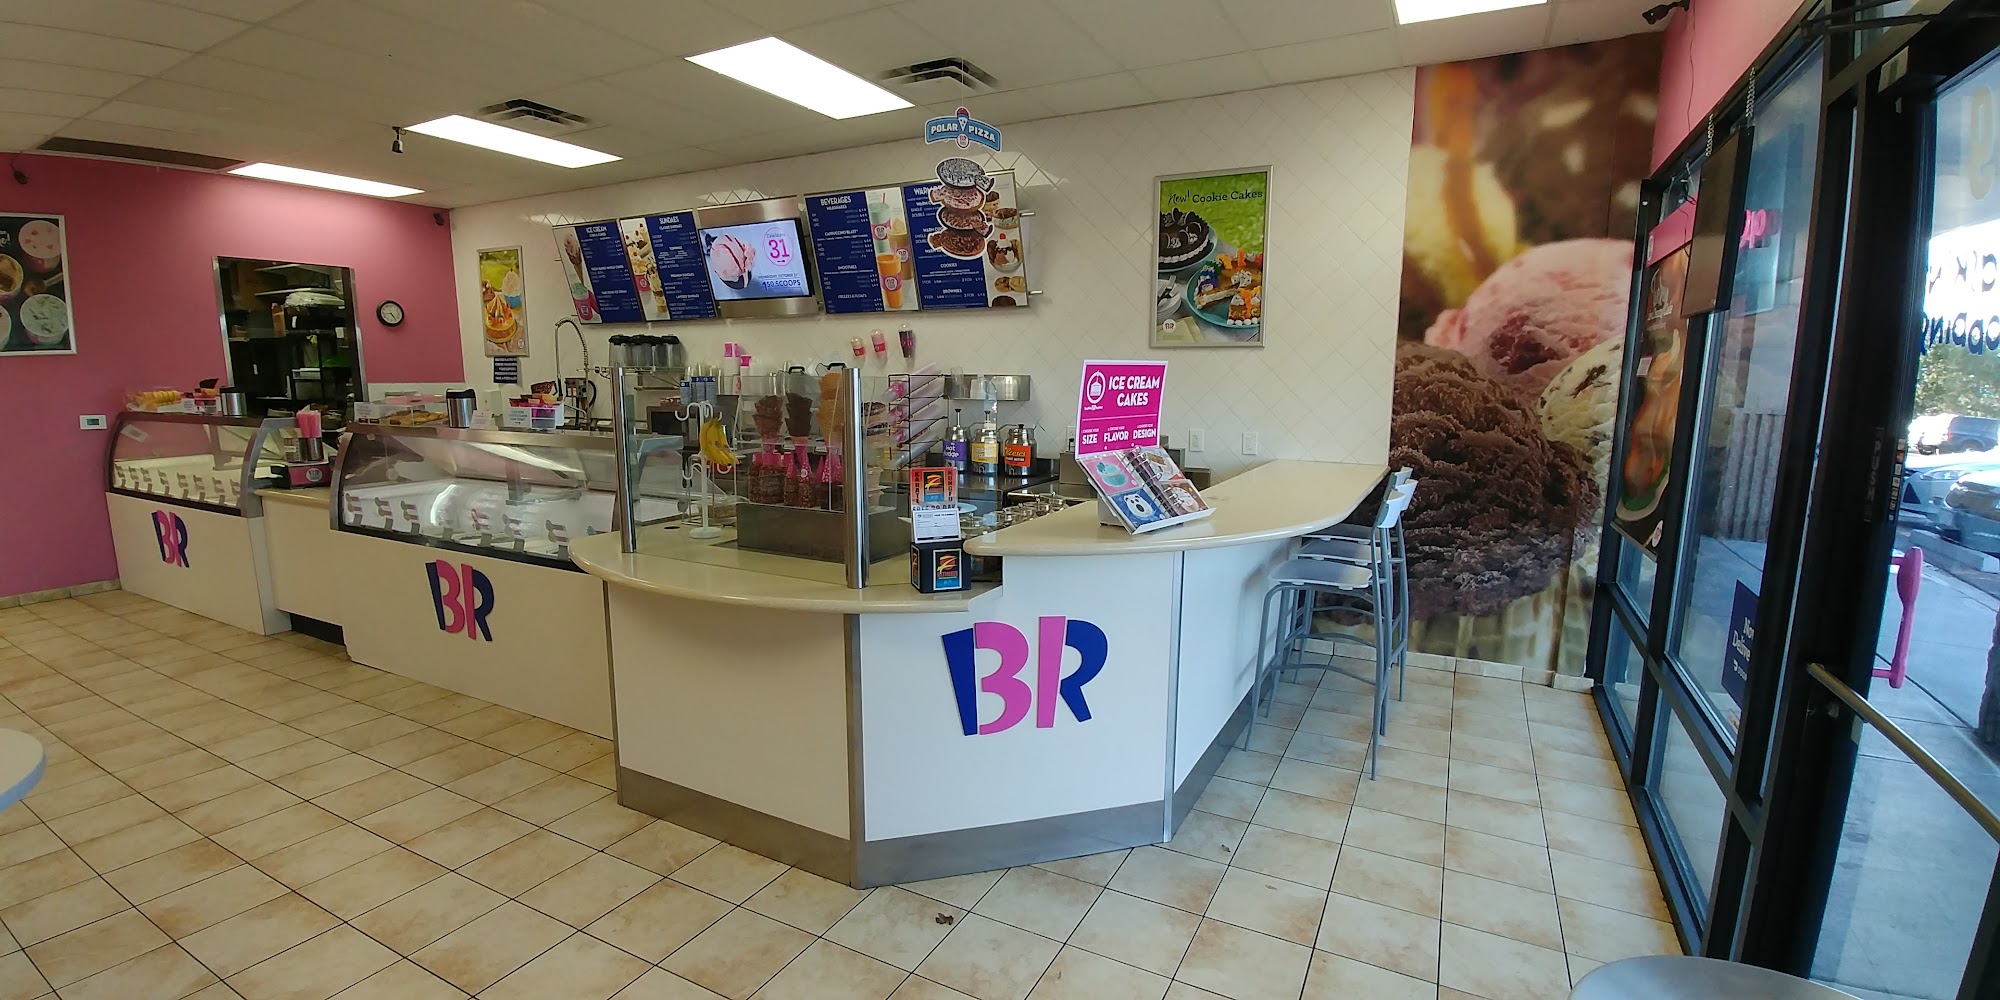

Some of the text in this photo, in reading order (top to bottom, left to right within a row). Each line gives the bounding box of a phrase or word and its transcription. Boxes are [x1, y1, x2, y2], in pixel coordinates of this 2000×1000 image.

[930, 123, 958, 135] POLAR
[968, 125, 996, 143] PIZZA
[820, 195, 851, 206] BEVERAGES
[1192, 193, 1228, 203] Cookie
[1230, 189, 1263, 201] Cakes
[659, 216, 679, 224] SUNDAES
[768, 238, 790, 258] 31
[775, 279, 801, 287] SCOOPS
[1108, 375, 1160, 390] ICE CREAM
[1116, 392, 1149, 407] CAKES
[1082, 433, 1098, 445] SIZE
[1103, 430, 1129, 443] FLAVOR
[1133, 427, 1157, 440] DESIGN
[945, 444, 956, 452] hot
[1867, 440, 1881, 502] PUSH
[151, 509, 190, 569] BR
[425, 559, 494, 642] BR
[941, 615, 1108, 736] BR
